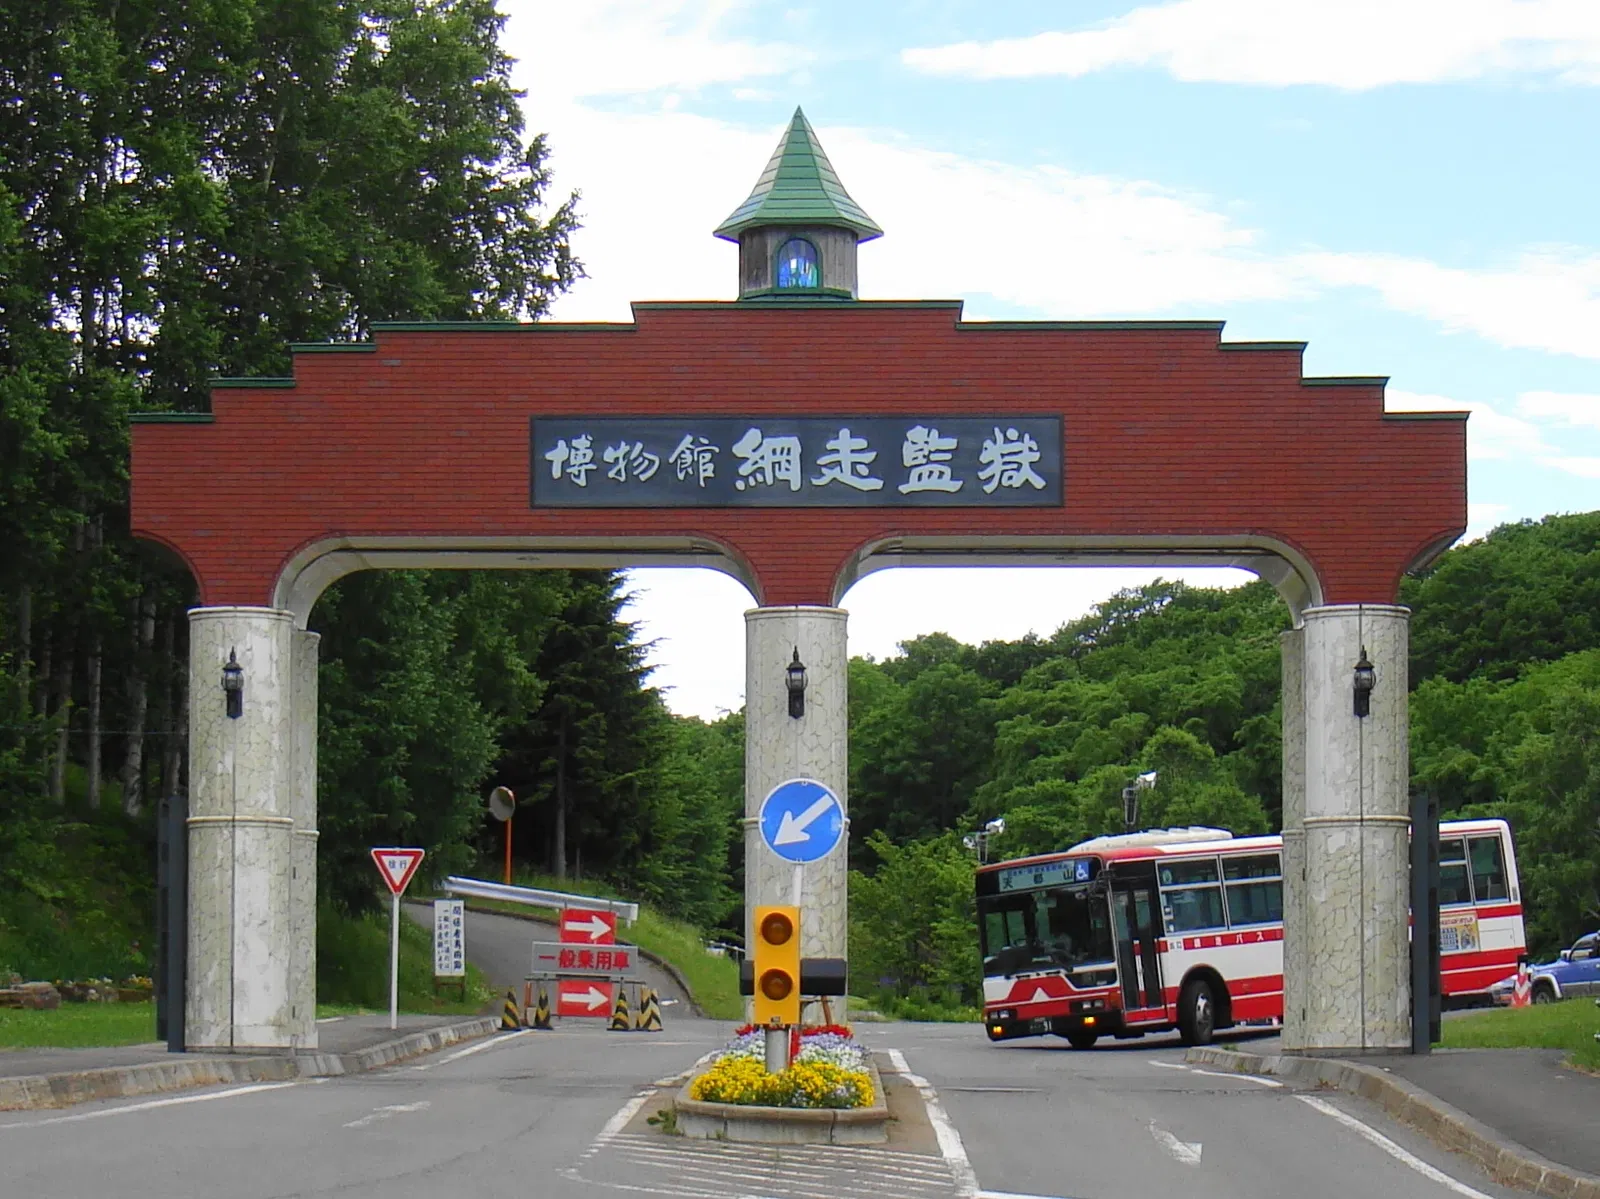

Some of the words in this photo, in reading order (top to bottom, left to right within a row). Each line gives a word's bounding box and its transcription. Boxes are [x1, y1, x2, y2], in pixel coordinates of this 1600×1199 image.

[545, 425, 1047, 494] 博物館網走監獄
[538, 947, 630, 972] 一般乗用車
